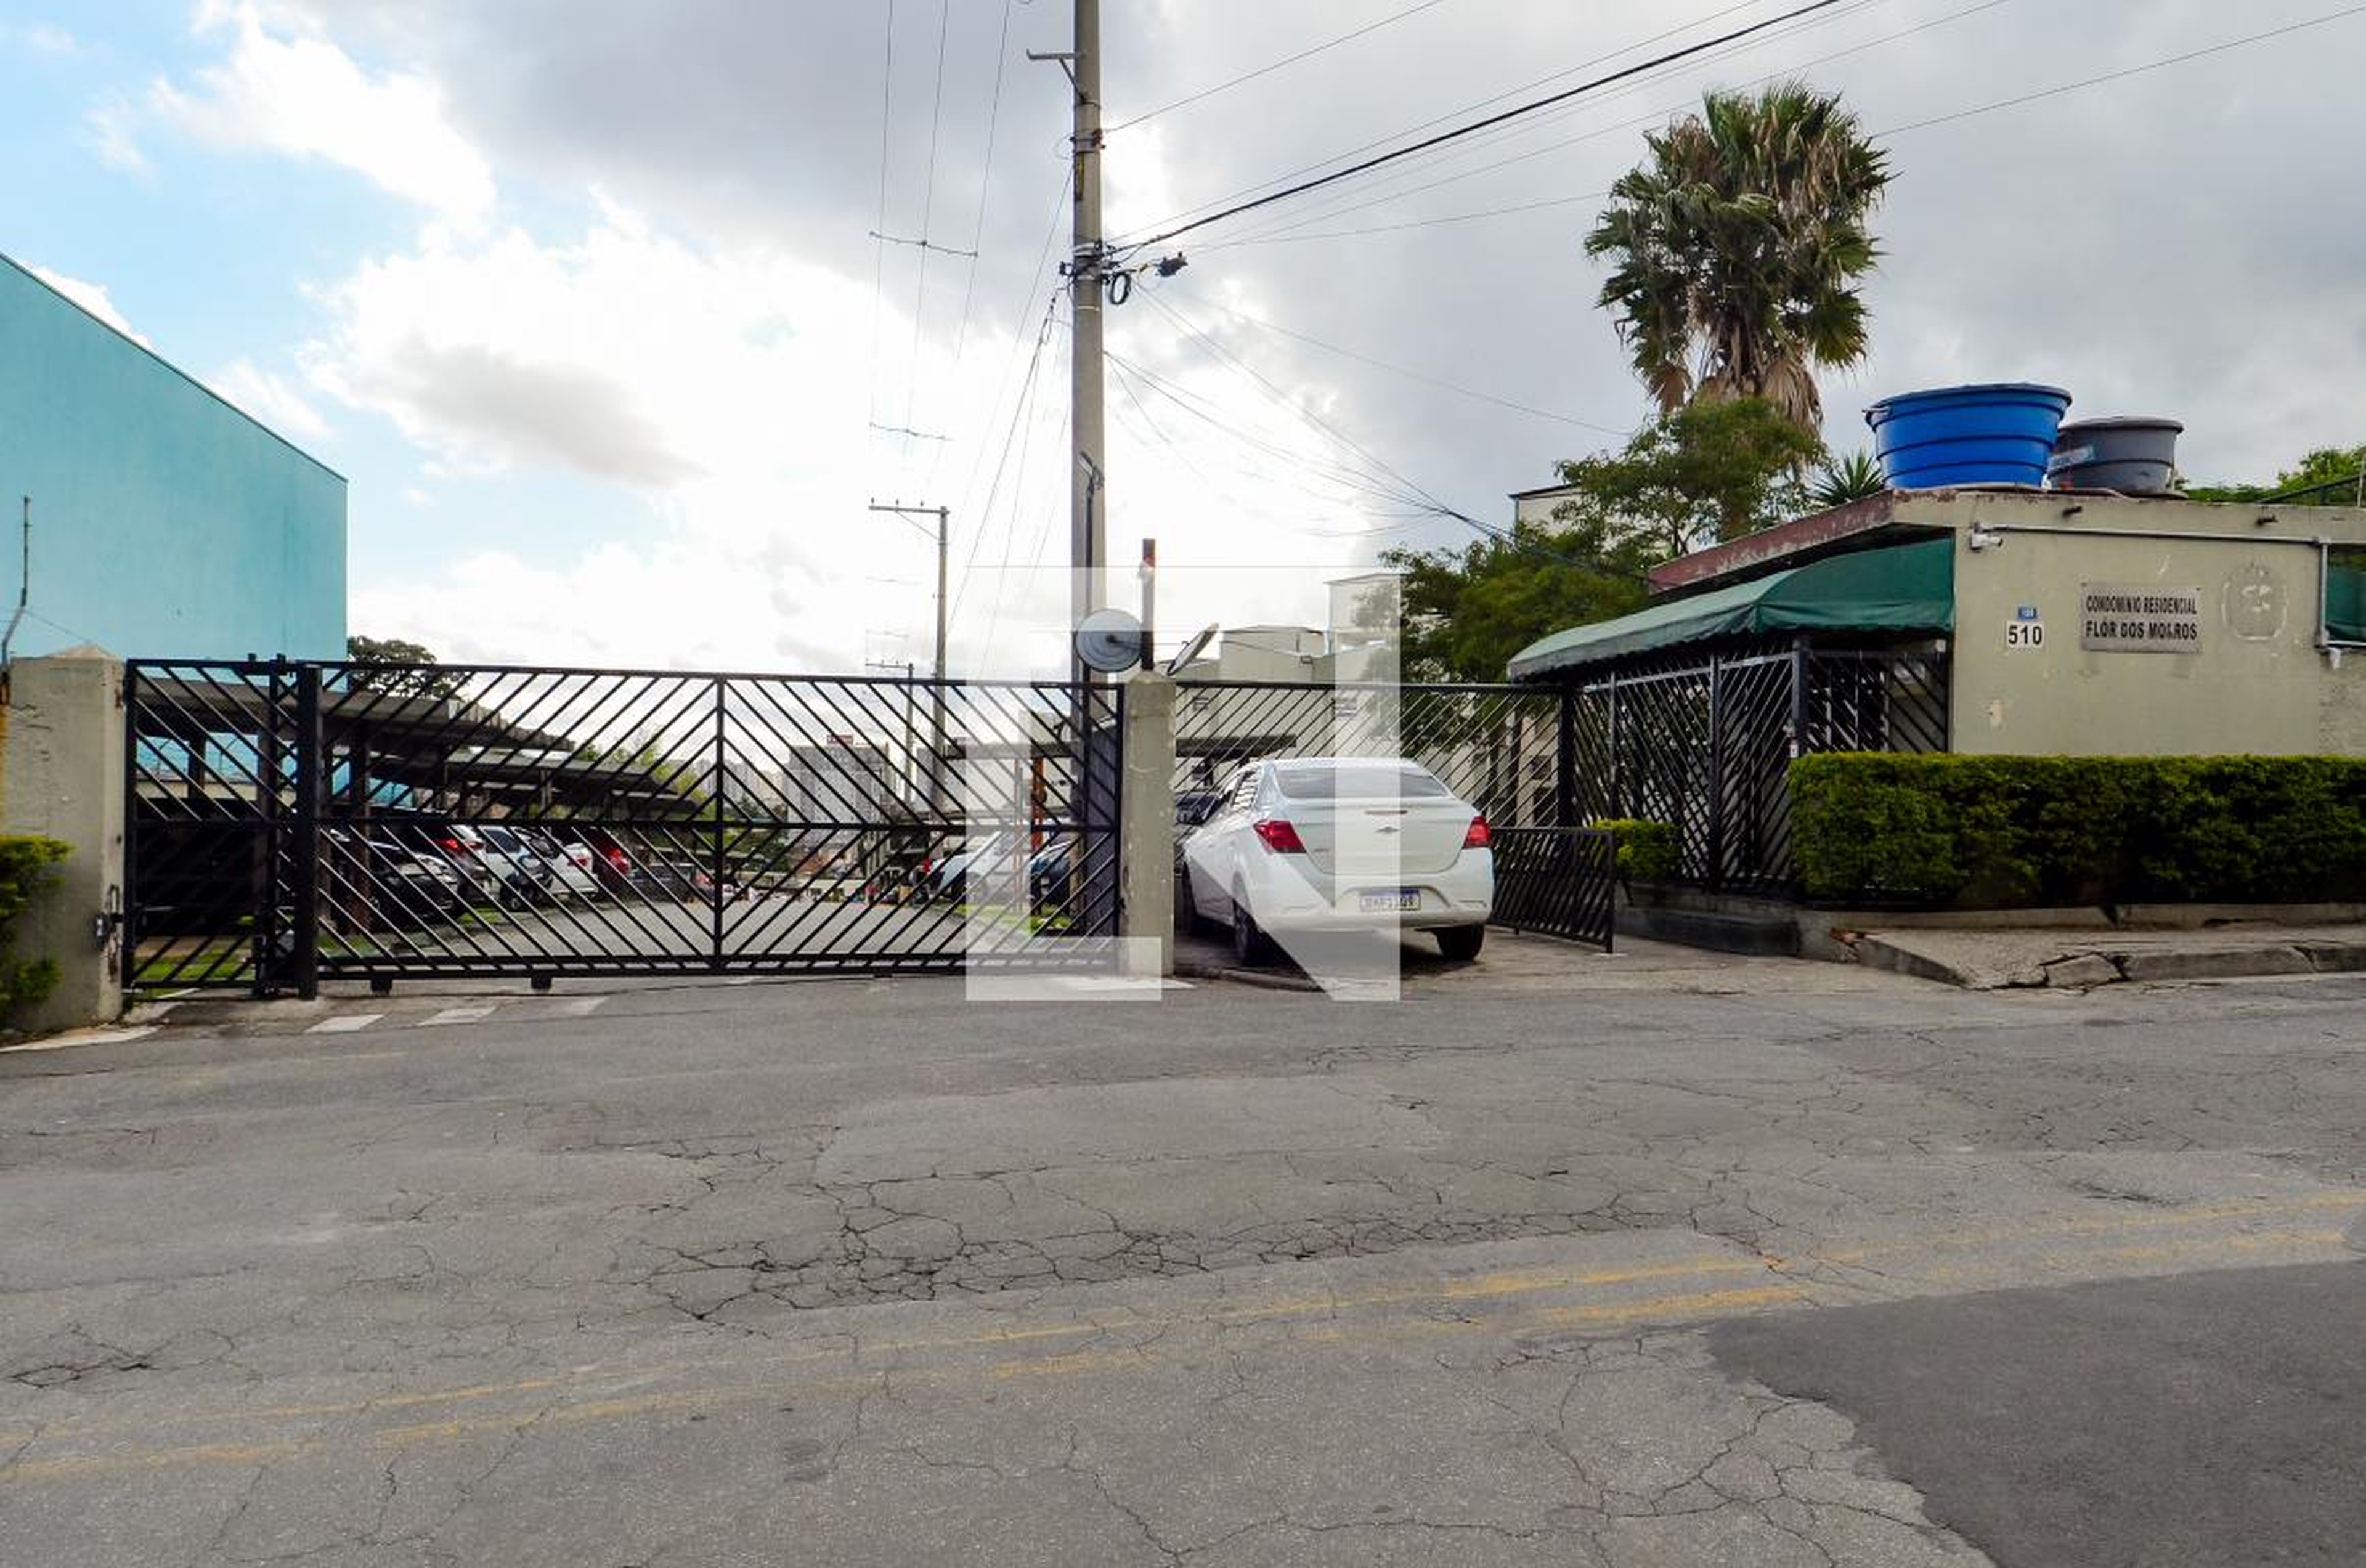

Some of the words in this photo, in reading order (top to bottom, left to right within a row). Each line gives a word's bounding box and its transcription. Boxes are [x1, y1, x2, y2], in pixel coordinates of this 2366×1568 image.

[2143, 596, 2197, 615] RESIDENCIAL
[2009, 625, 2042, 645] 510
[2086, 620, 2117, 638] FLOR
[2121, 622, 2144, 639] DOS
